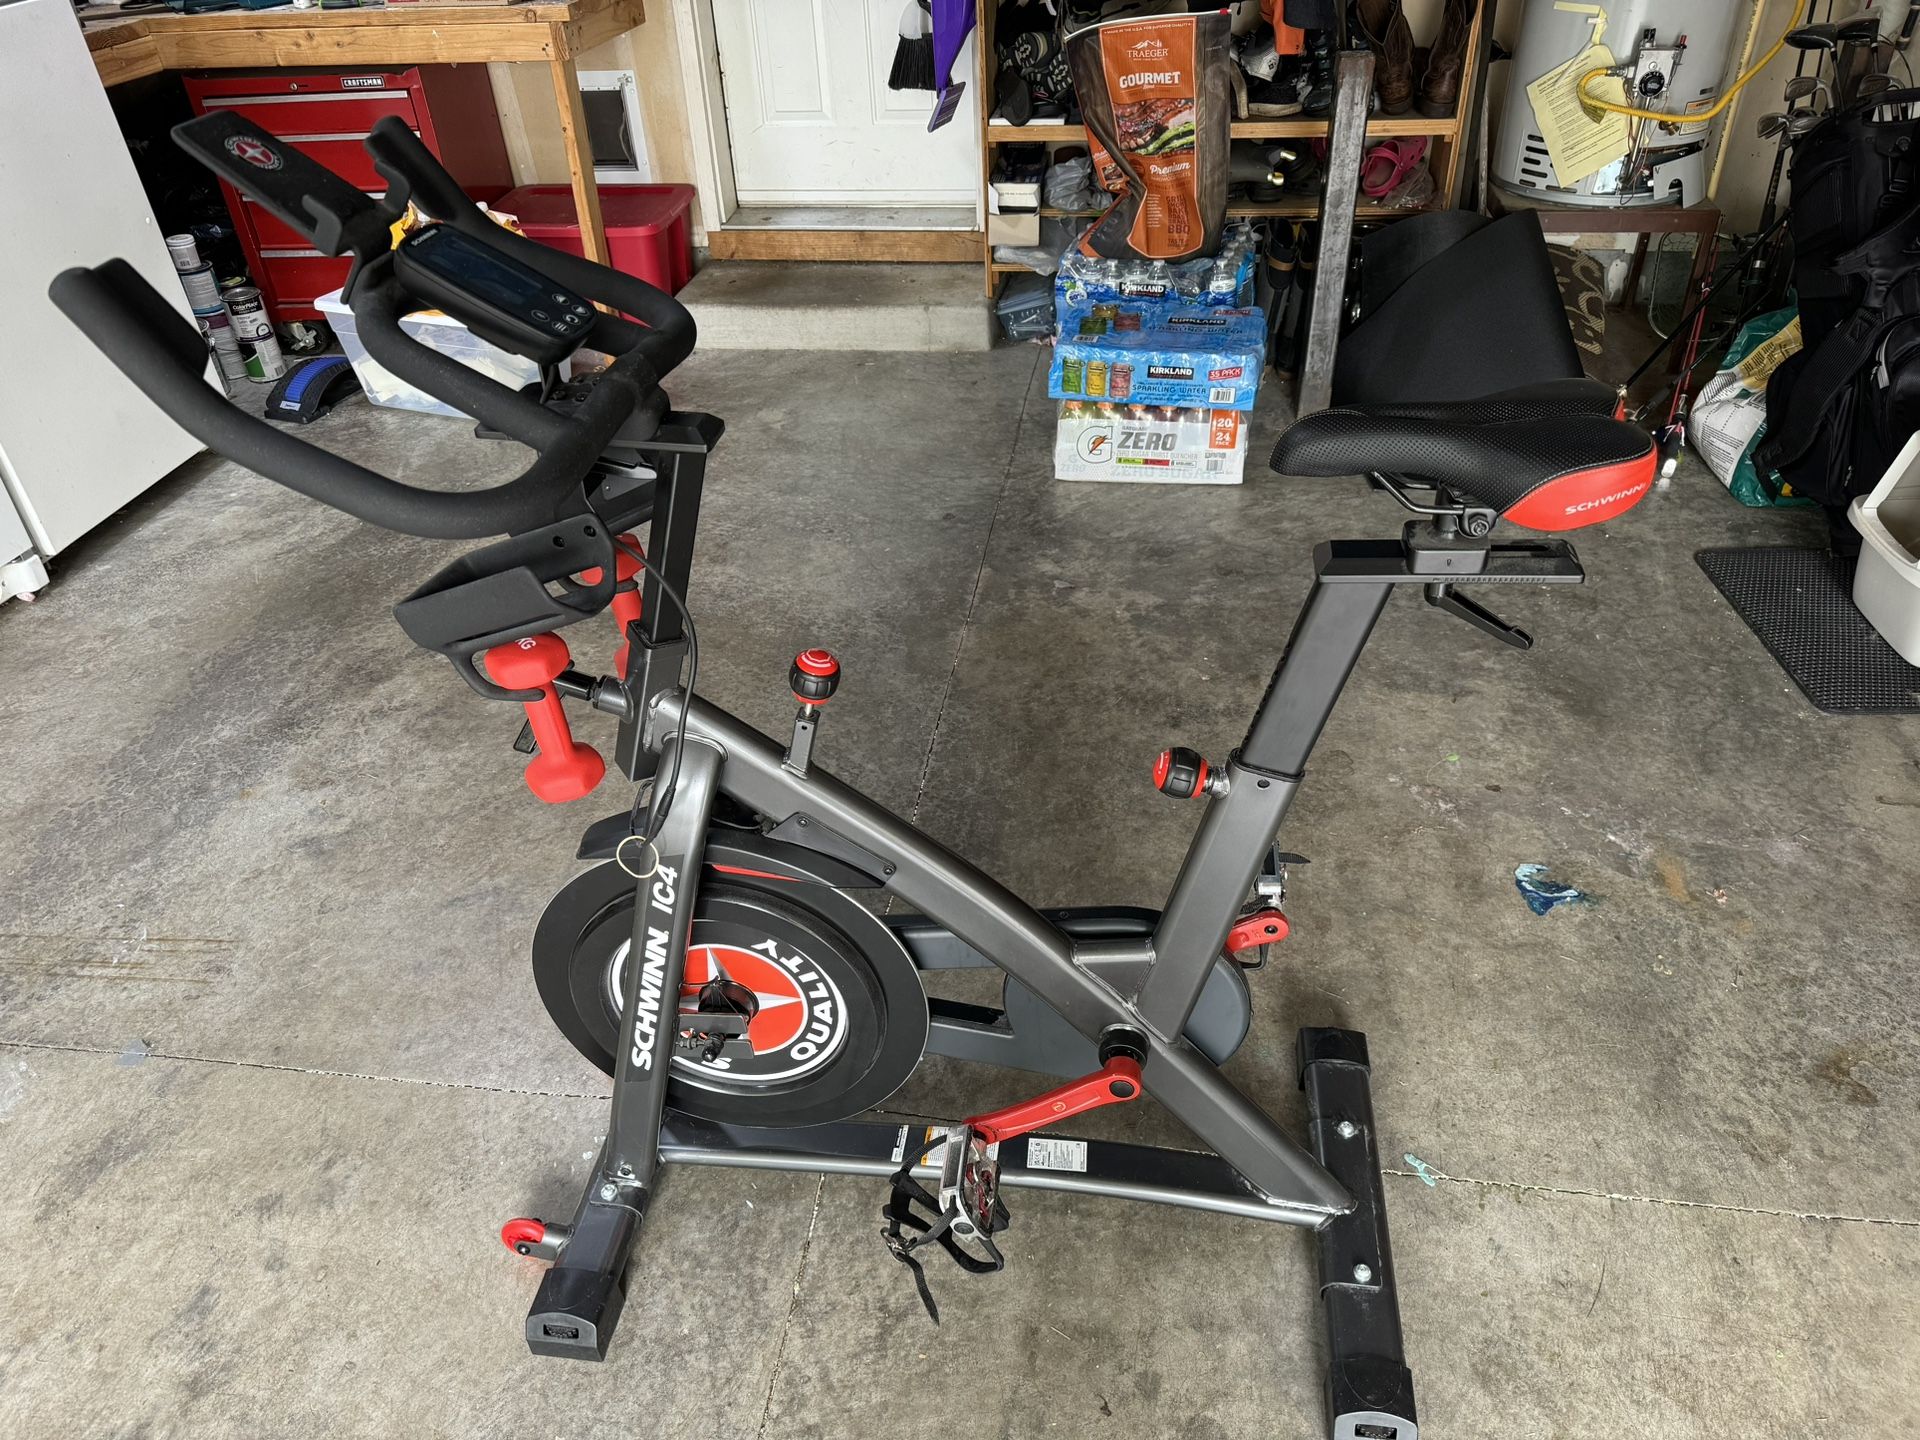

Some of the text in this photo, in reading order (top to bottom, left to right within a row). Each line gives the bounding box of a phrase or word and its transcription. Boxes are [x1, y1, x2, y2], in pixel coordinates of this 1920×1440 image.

[1127, 48, 1169, 58] TRAEGER
[343, 78, 383, 88] CRAFTSMAN
[1119, 71, 1181, 89] GOURMET
[1149, 161, 1191, 175] Premium
[1167, 224, 1190, 236] BBQ
[1121, 283, 1164, 293] KIRKLAND
[1149, 366, 1193, 376] KIRKLAND
[1210, 368, 1241, 379] 35 PACK
[1132, 384, 1176, 393] SPARKLING
[1216, 417, 1232, 428] 20
[1117, 431, 1178, 451] ZERO
[1215, 431, 1231, 441] 24
[1076, 425, 1113, 464] G
[1564, 483, 1643, 515] SCHWINN
[651, 866, 679, 915] IC4
[631, 926, 670, 1071] SCHWINN
[751, 938, 833, 1061] QUALITY
